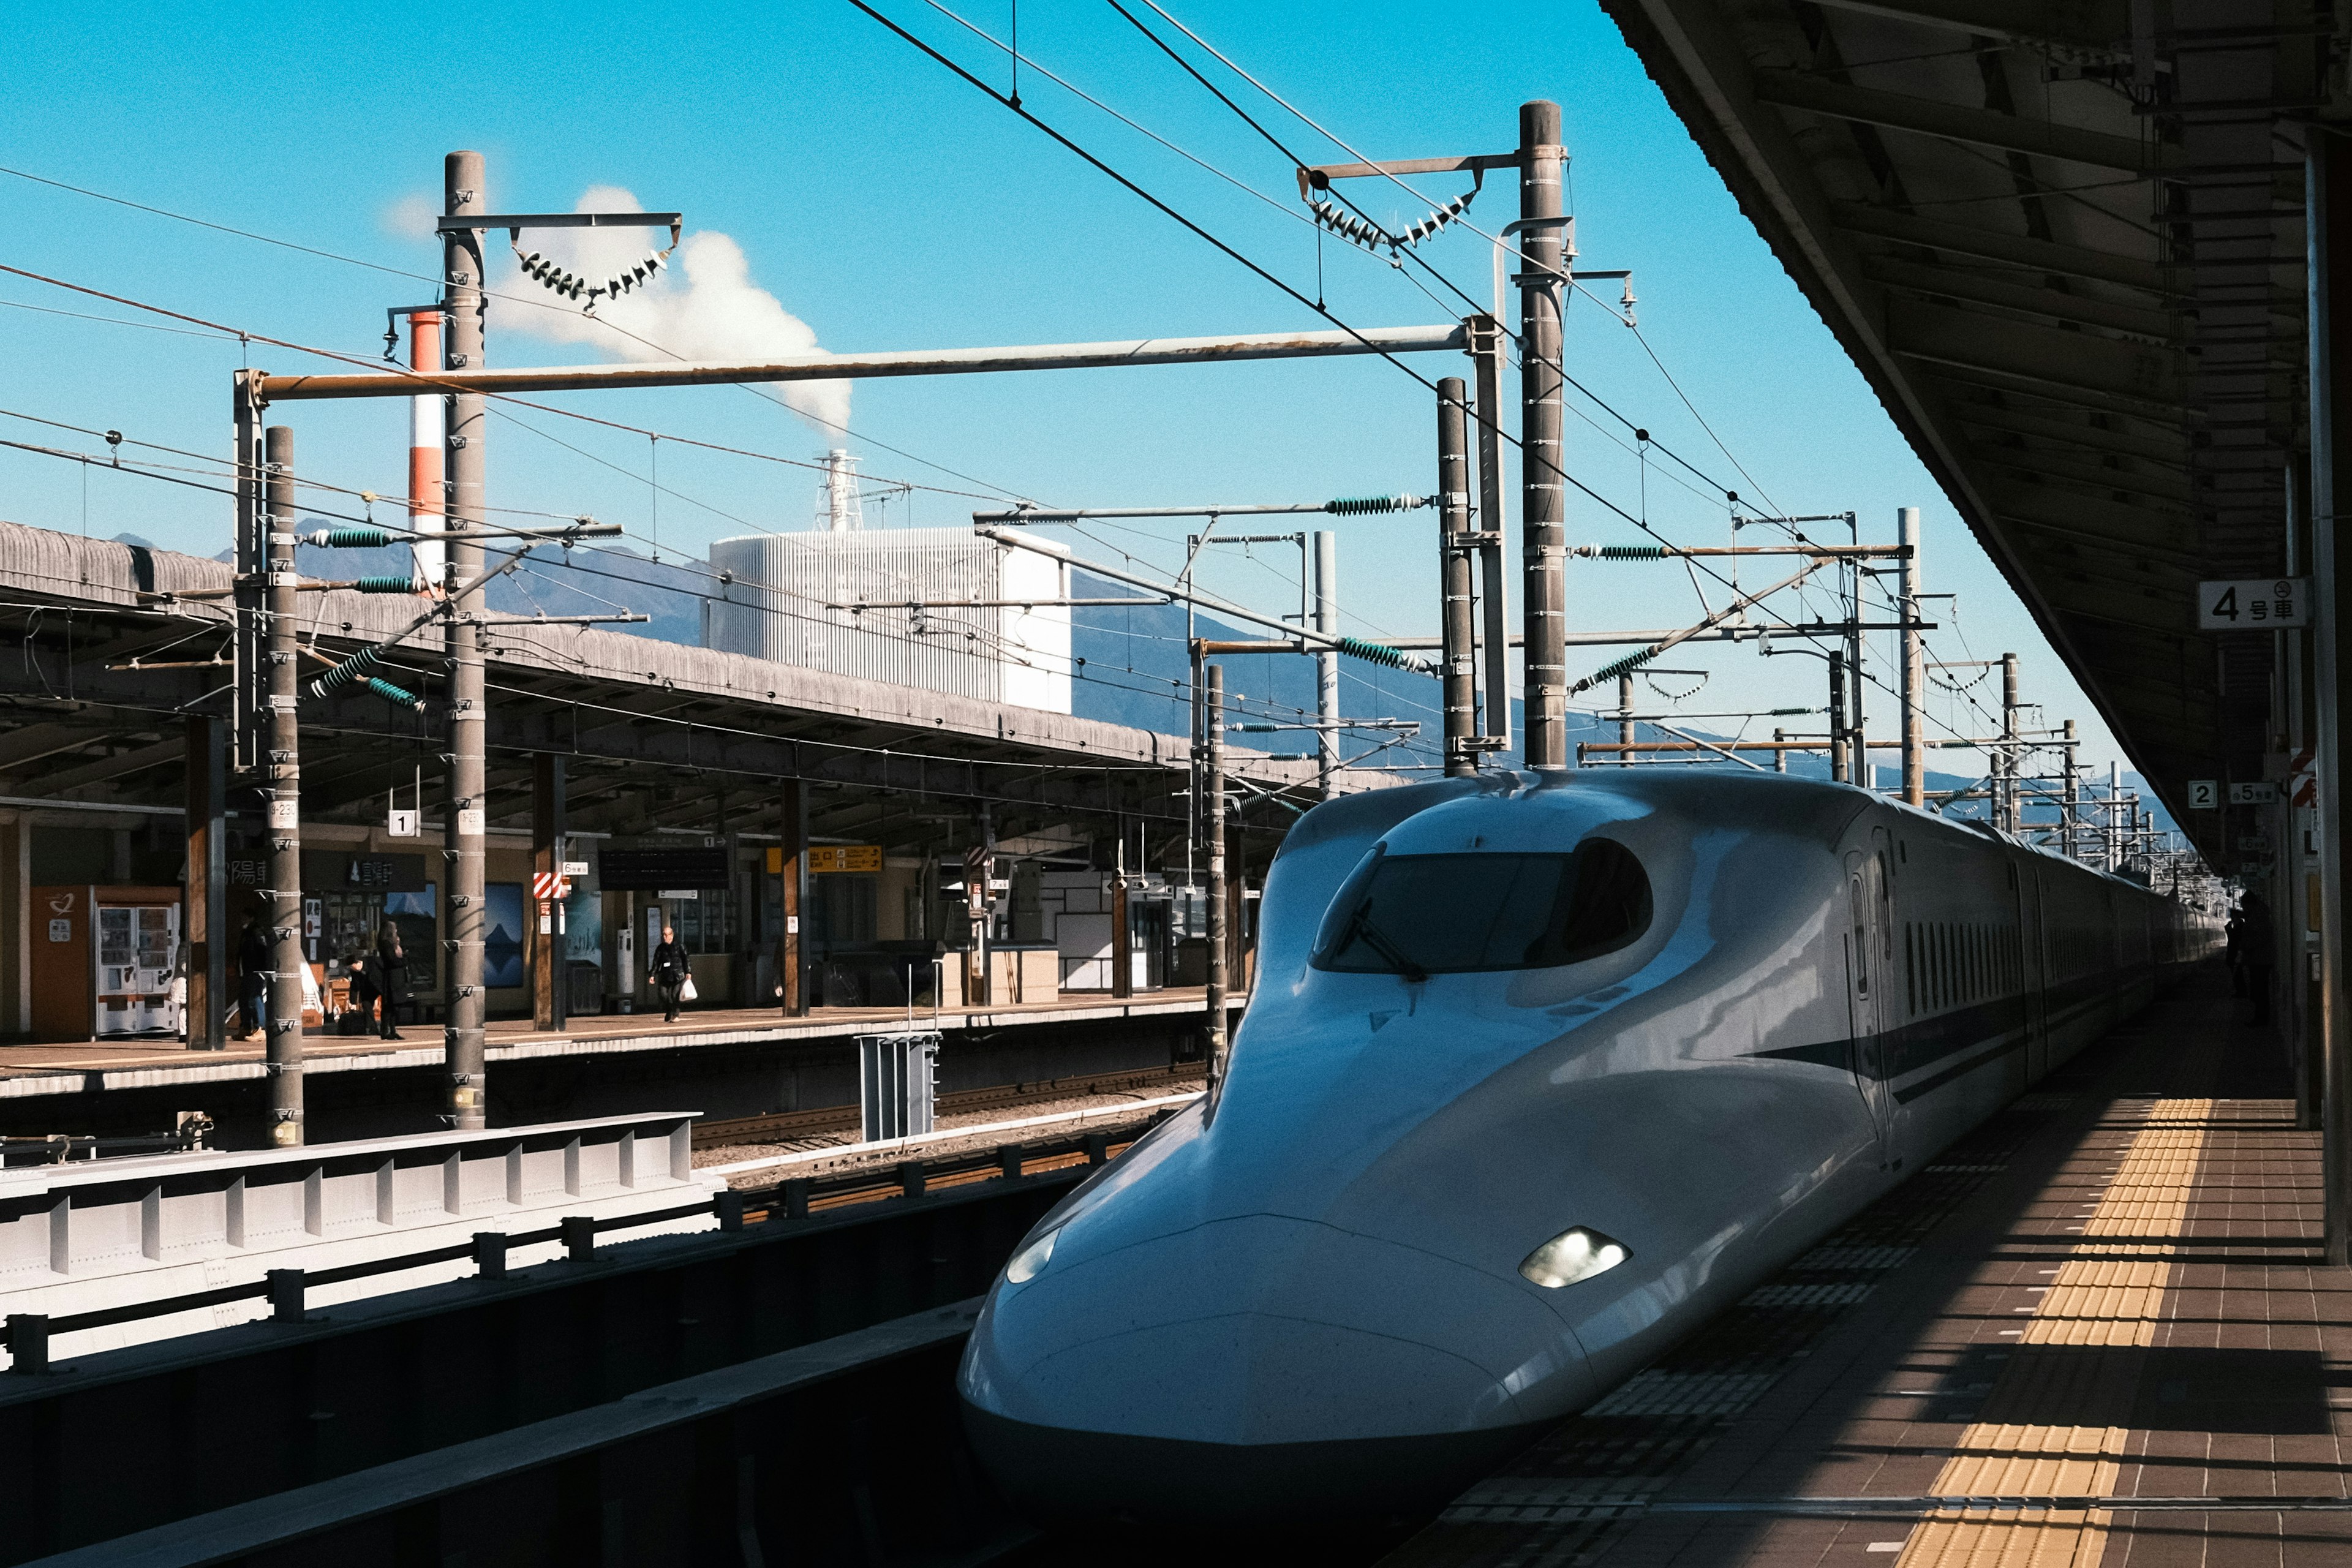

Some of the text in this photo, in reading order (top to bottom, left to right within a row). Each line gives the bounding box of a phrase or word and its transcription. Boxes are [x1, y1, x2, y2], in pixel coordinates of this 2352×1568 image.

[2213, 586, 2293, 620] 4号車
[2197, 786, 2209, 802] 2
[398, 816, 404, 832] 1
